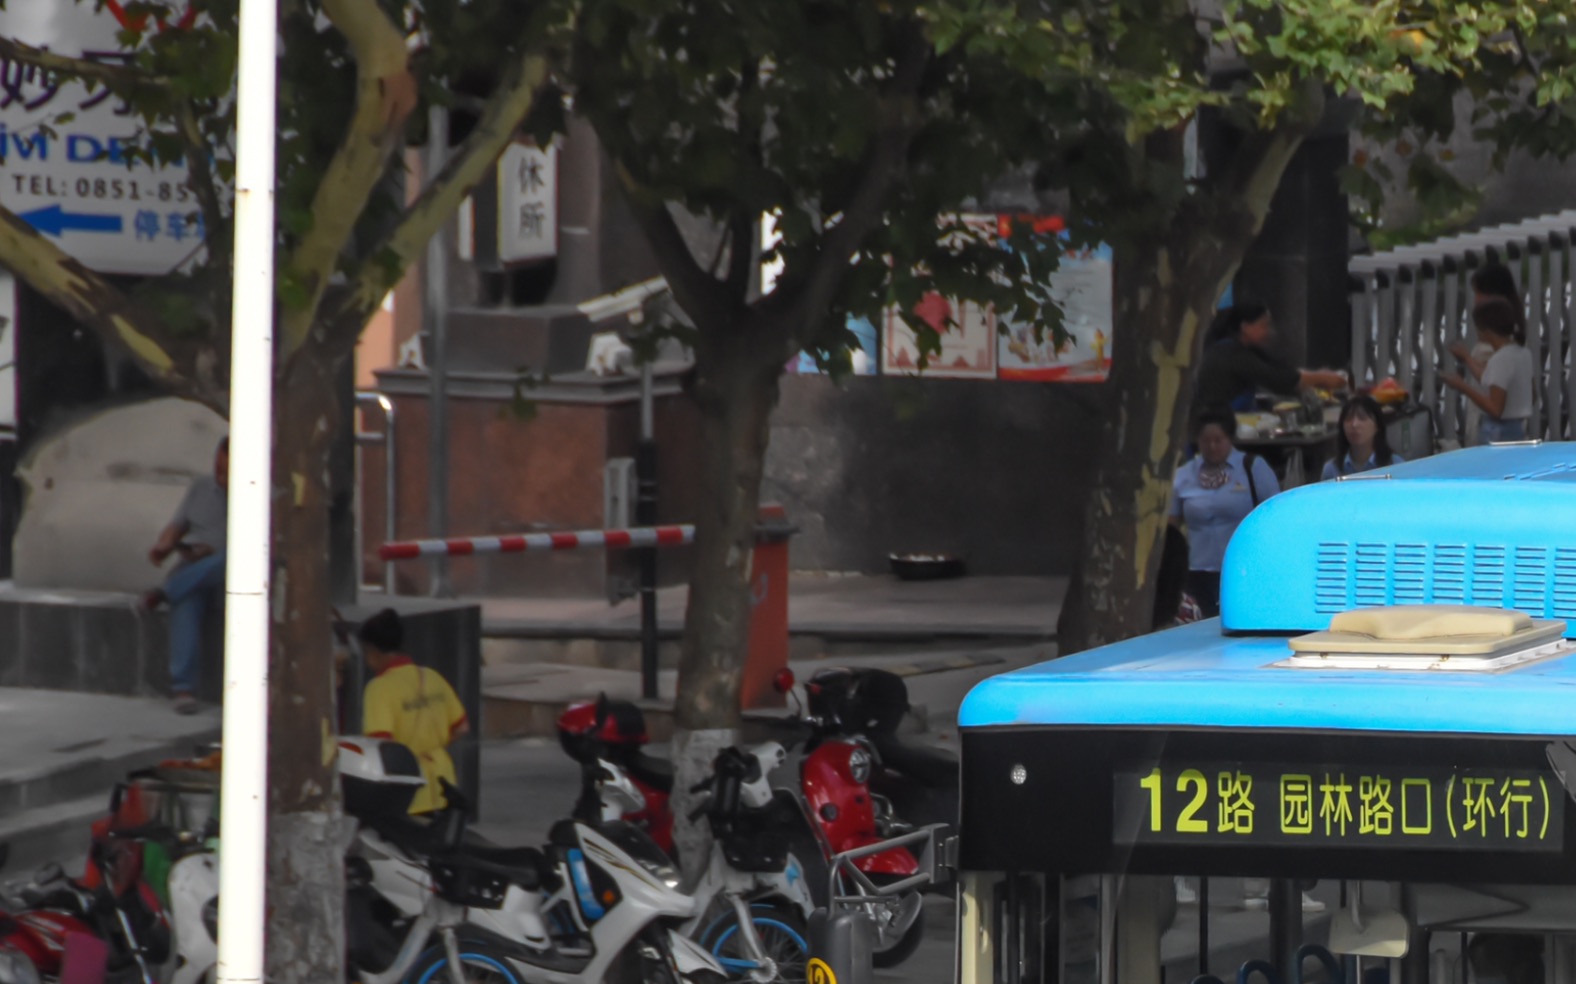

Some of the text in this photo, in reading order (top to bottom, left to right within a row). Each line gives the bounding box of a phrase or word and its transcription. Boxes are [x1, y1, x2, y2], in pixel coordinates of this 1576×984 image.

[12, 174, 192, 204] TEL: 0851-85
[133, 208, 206, 242] 停车
